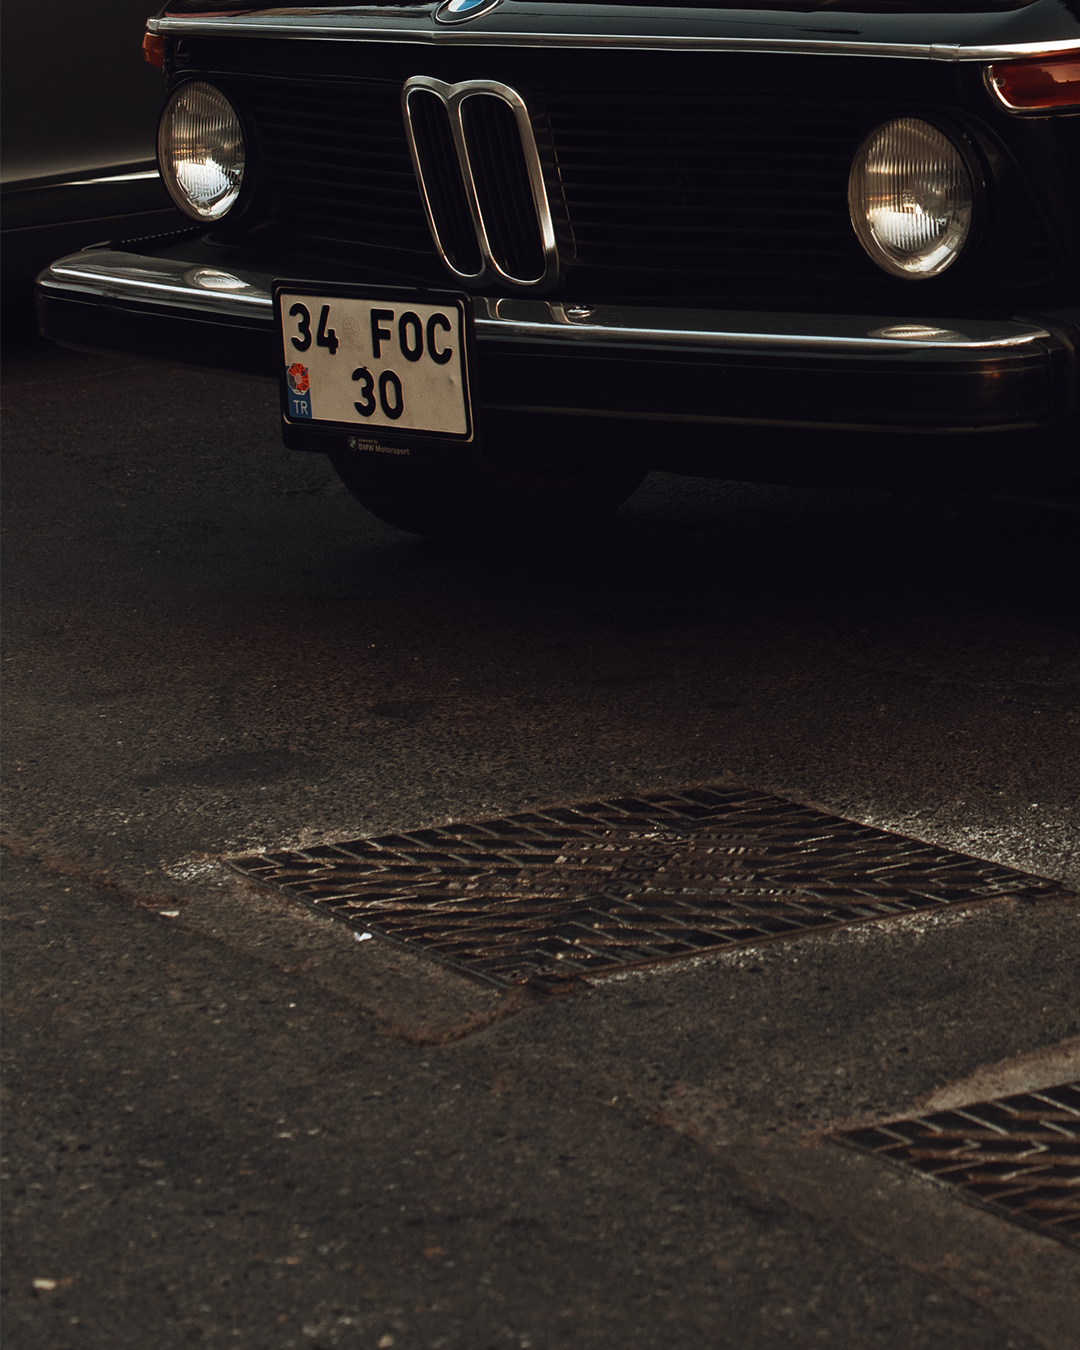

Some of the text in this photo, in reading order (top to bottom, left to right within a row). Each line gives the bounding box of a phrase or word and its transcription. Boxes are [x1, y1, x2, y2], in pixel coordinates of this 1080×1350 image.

[289, 302, 453, 365] 34 FOC
[292, 399, 309, 415] TR
[351, 366, 404, 419] 30
[358, 443, 411, 456] BMW Motorsport
